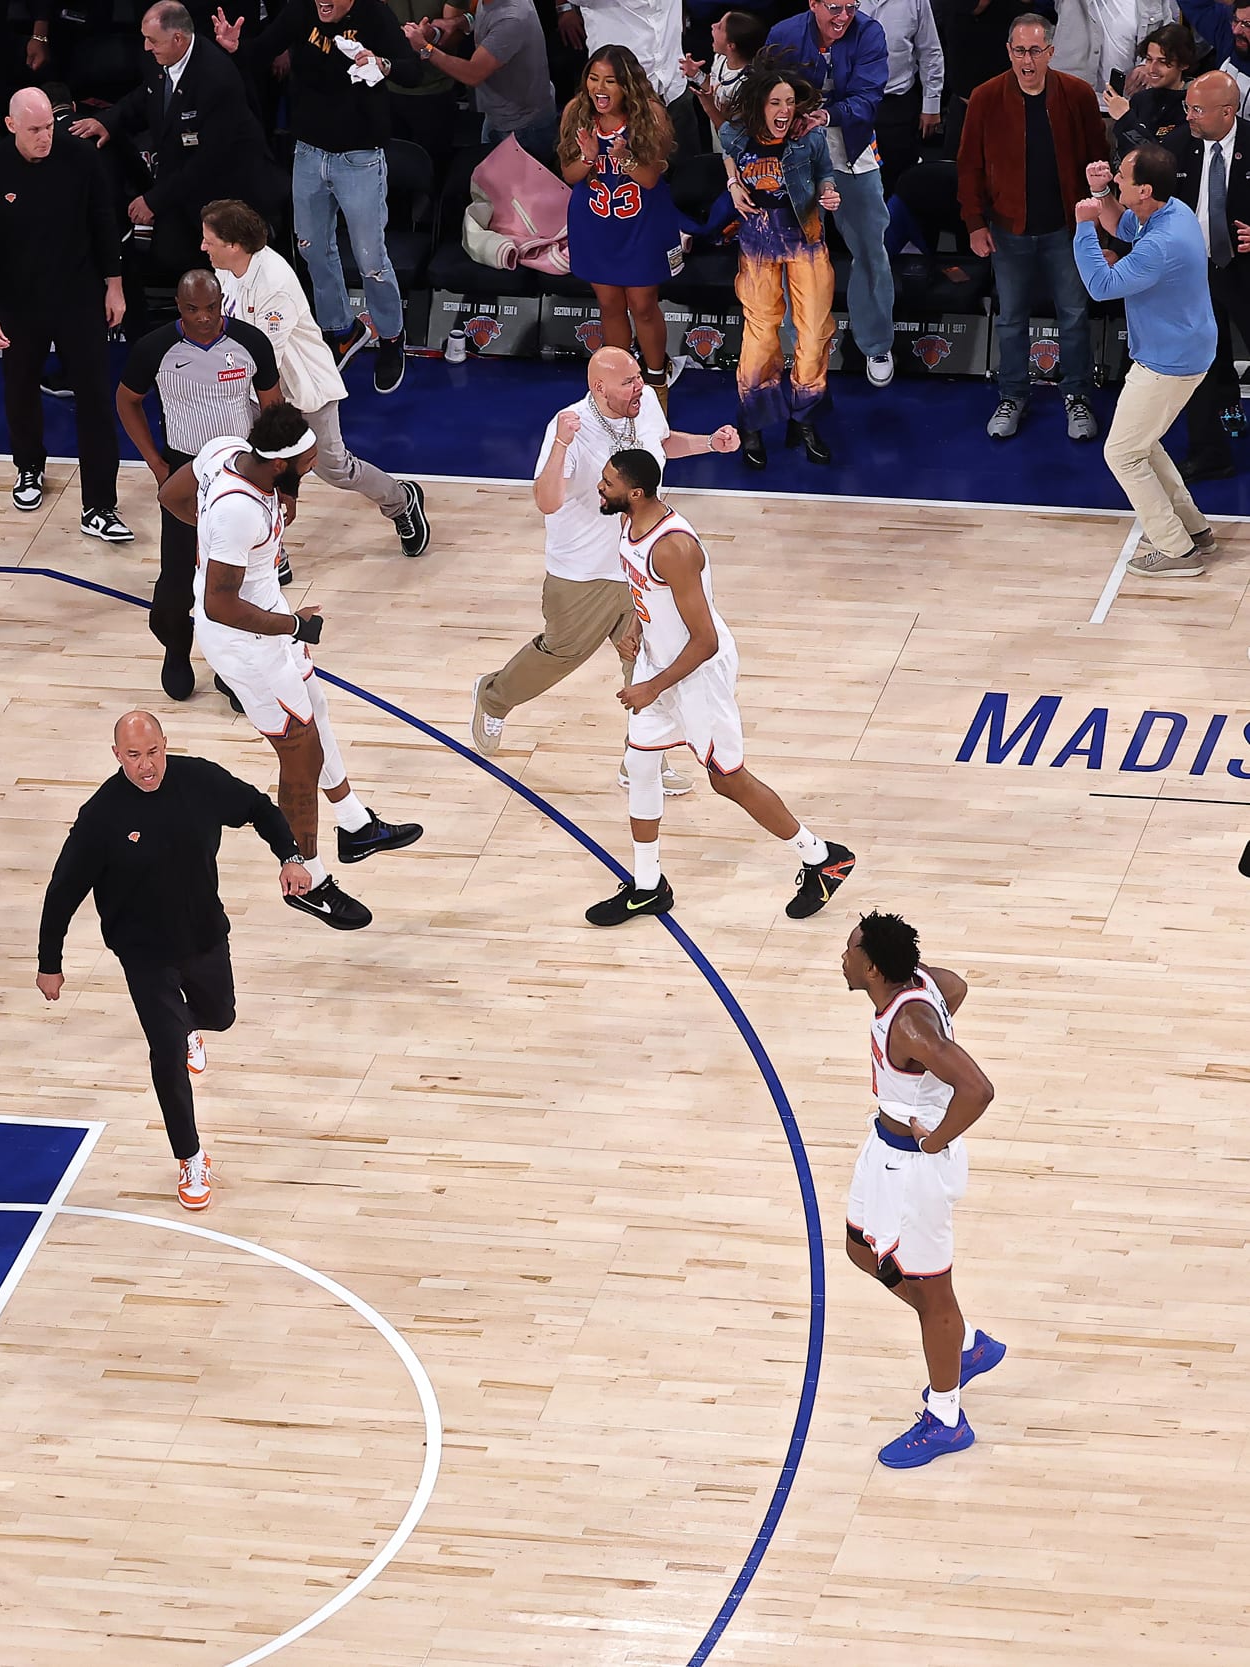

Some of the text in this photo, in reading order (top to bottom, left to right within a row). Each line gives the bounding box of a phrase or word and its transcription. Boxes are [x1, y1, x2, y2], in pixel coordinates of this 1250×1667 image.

[741, 160, 784, 179] KNICK
[589, 179, 642, 219] 33
[218, 370, 246, 380] Emirates
